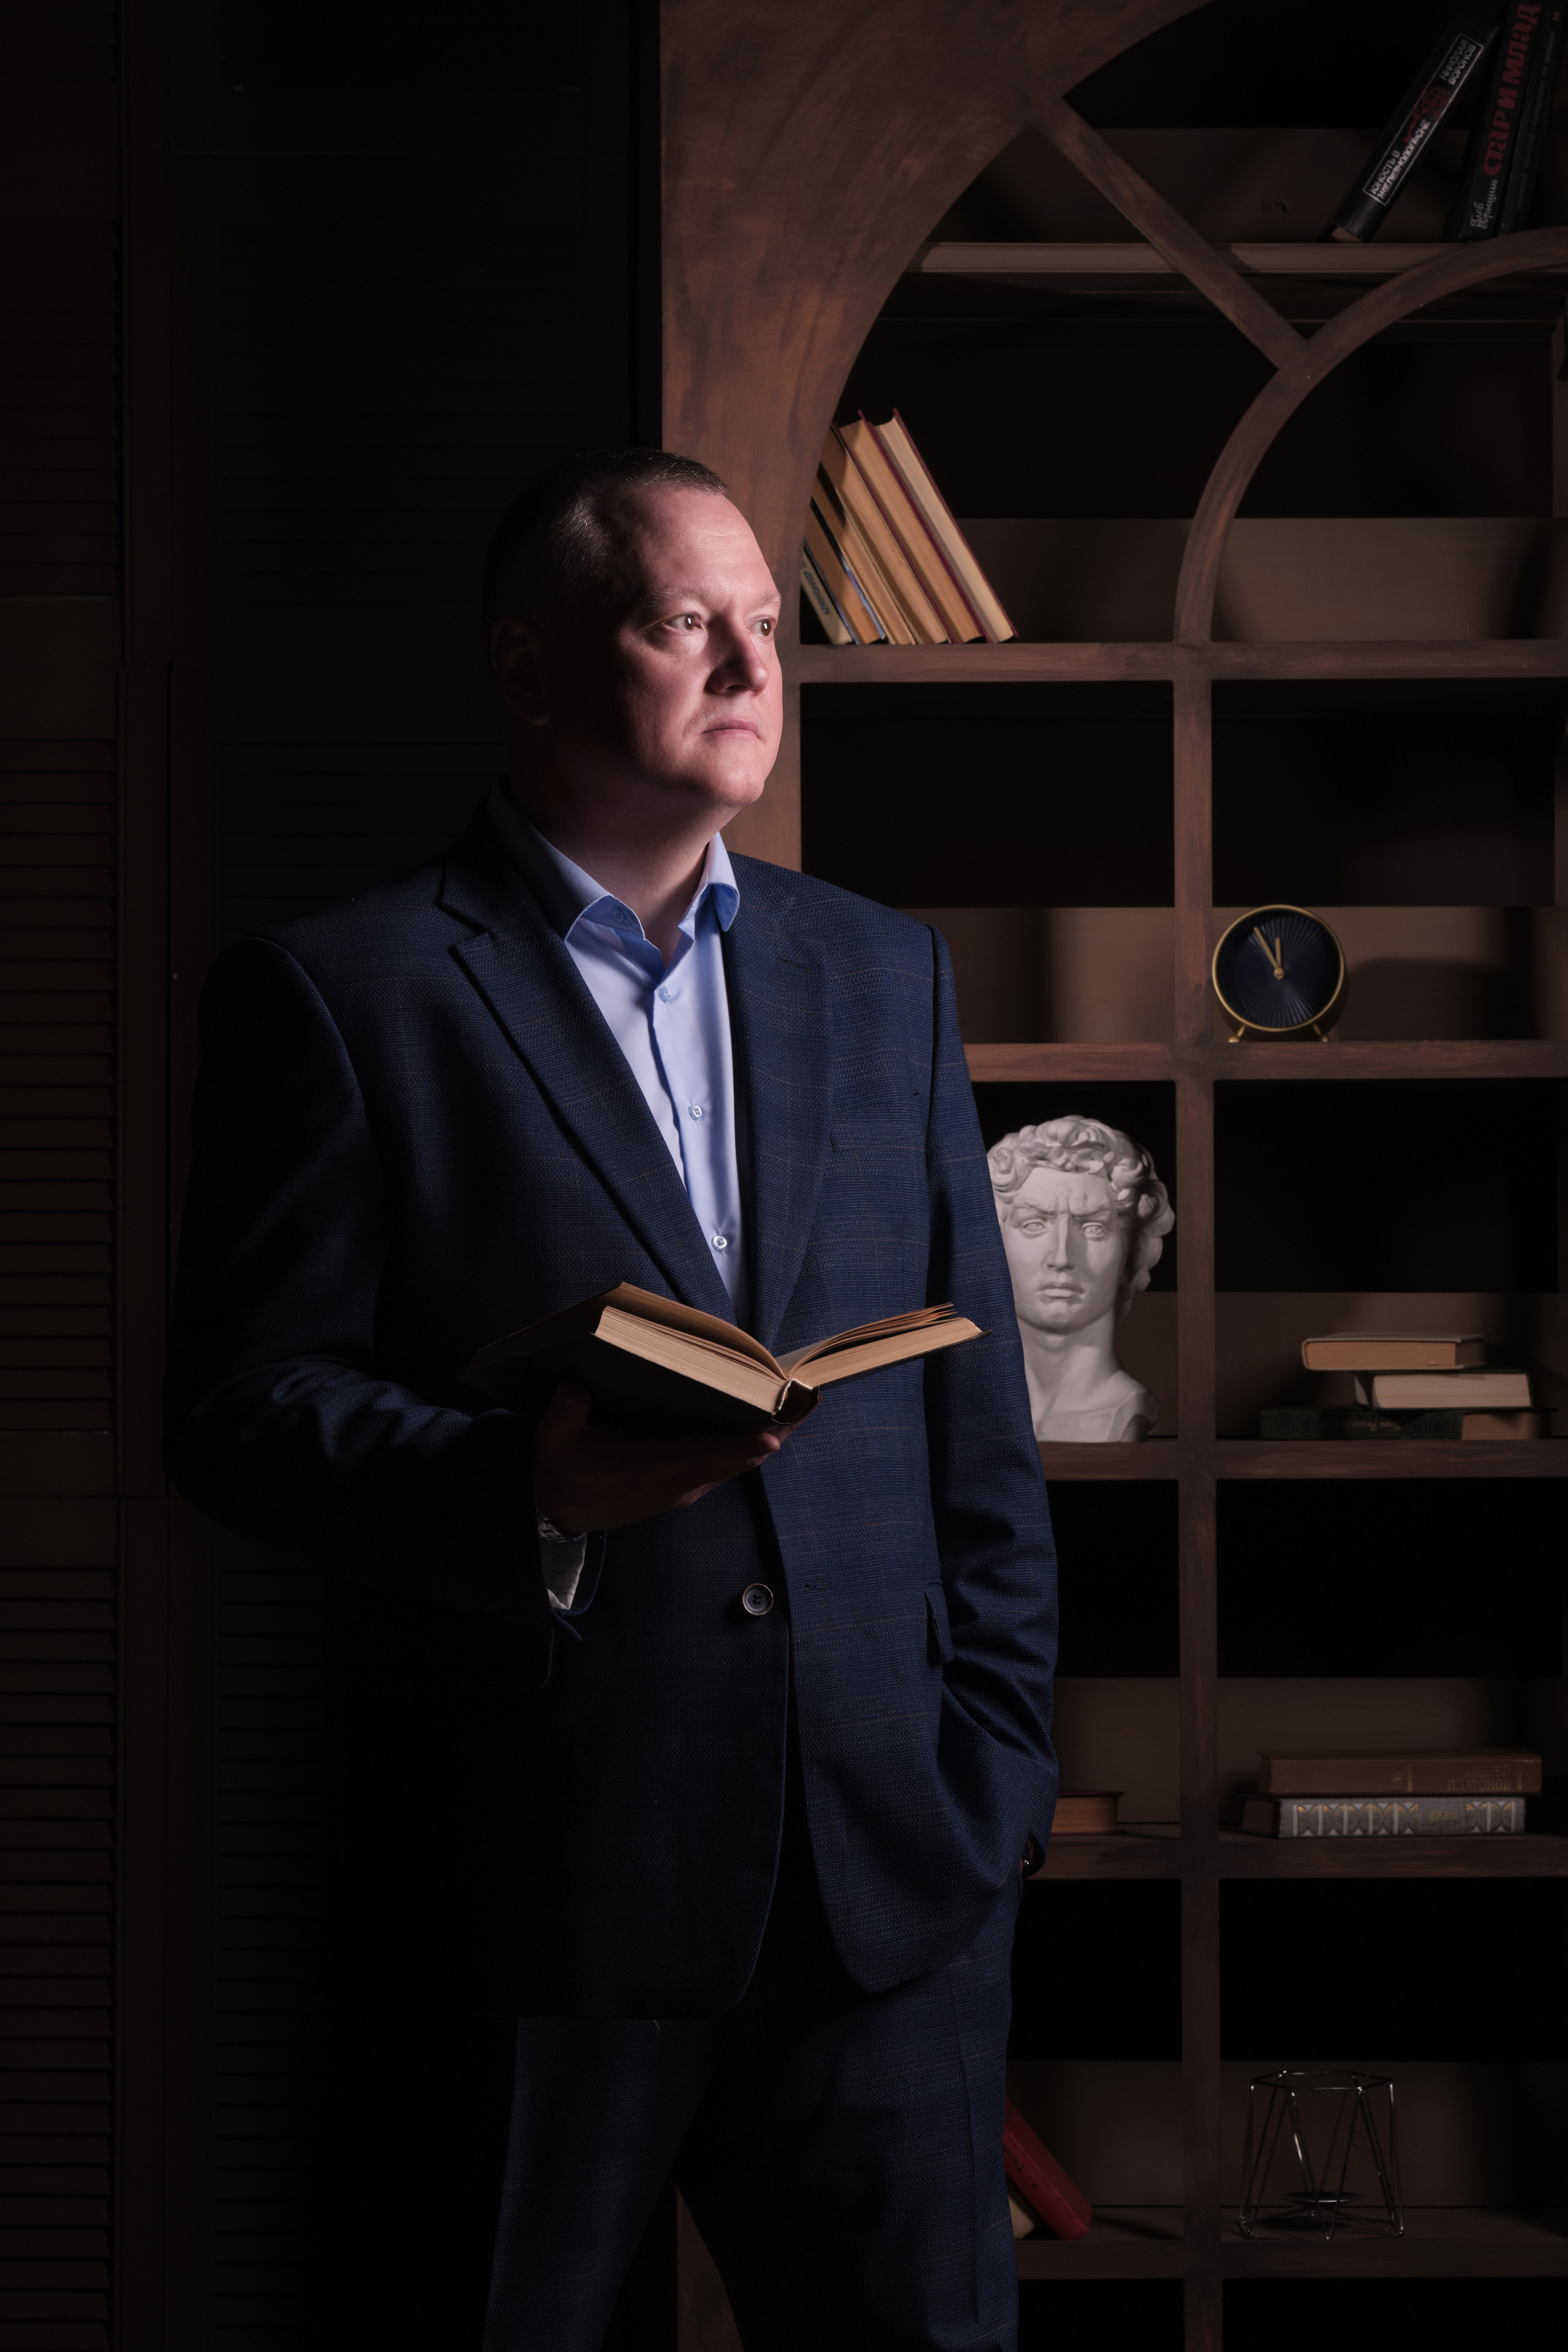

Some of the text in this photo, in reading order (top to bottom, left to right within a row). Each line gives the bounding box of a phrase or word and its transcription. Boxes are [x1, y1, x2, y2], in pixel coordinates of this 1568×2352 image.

[1448, 44, 1476, 85] ВОРОНОВ
[1498, 86, 1518, 109] И
[1371, 149, 1401, 194] ЮНОСТЬ В
[1464, 1763, 1511, 1777] АНДРЕЙ
[1447, 1779, 1510, 1790] ПЛАТОНОВ
